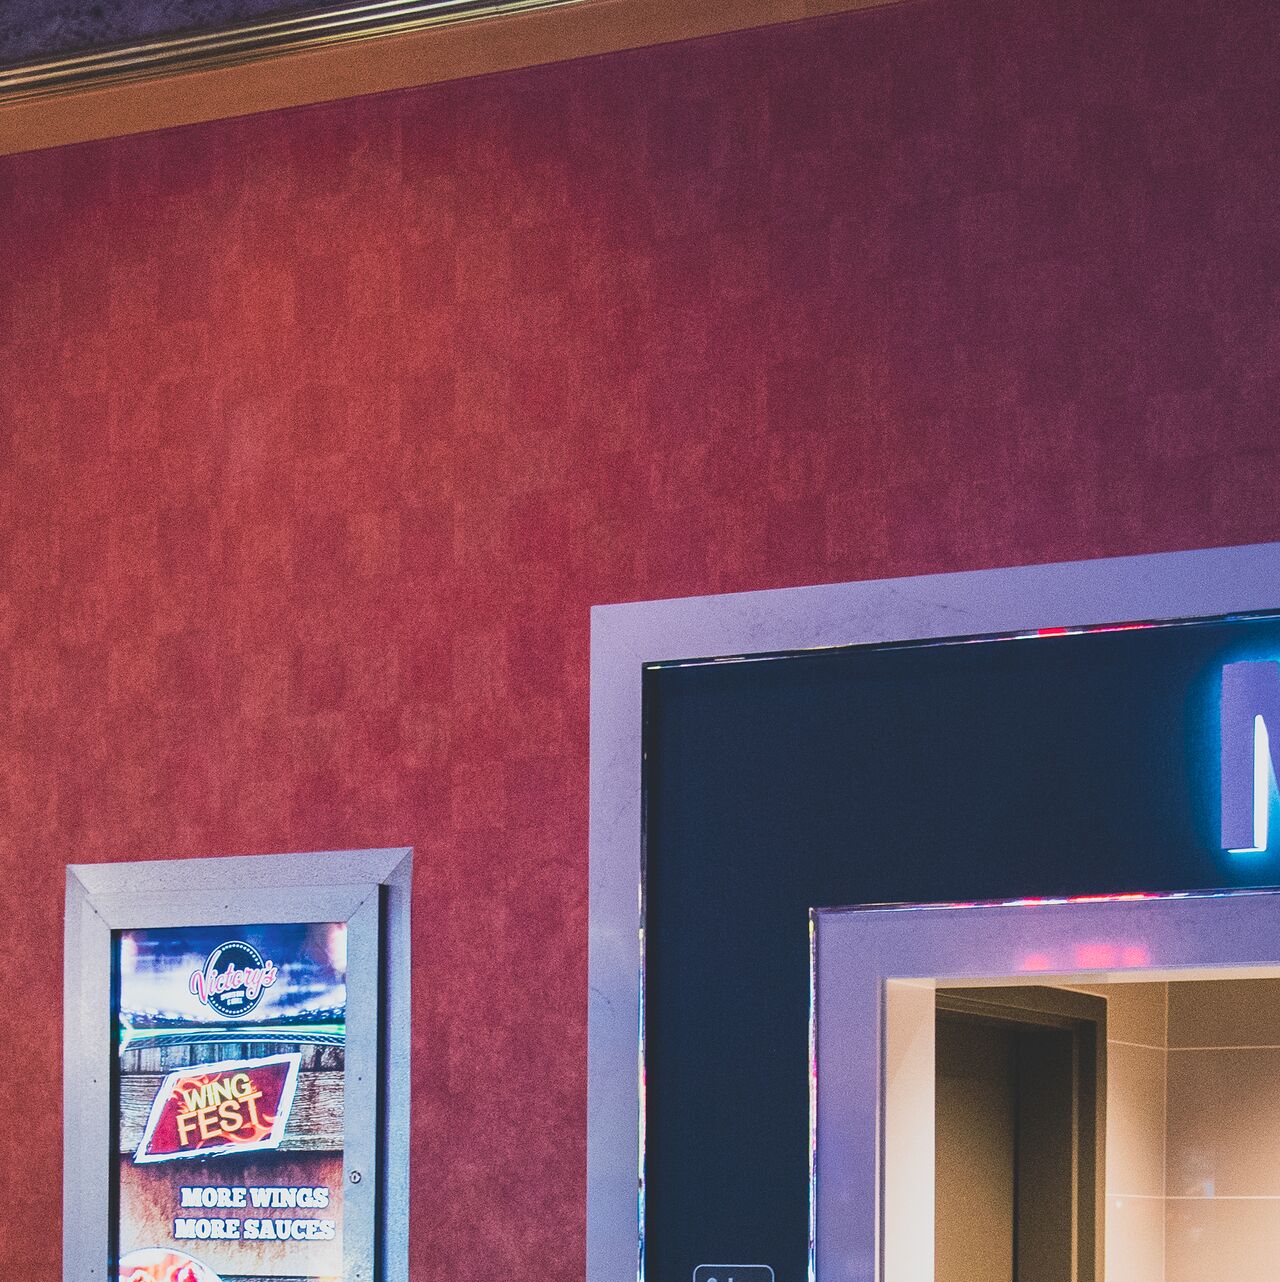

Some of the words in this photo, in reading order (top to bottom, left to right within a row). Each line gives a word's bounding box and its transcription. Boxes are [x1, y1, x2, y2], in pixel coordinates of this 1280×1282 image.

[189, 949, 278, 1005] Victory's
[183, 1073, 251, 1112] WING
[176, 1091, 263, 1146] FEST
[180, 1187, 247, 1209] MORE
[249, 1187, 329, 1209] WINGS
[174, 1218, 240, 1240] MORE
[243, 1218, 336, 1241] SAUCES
